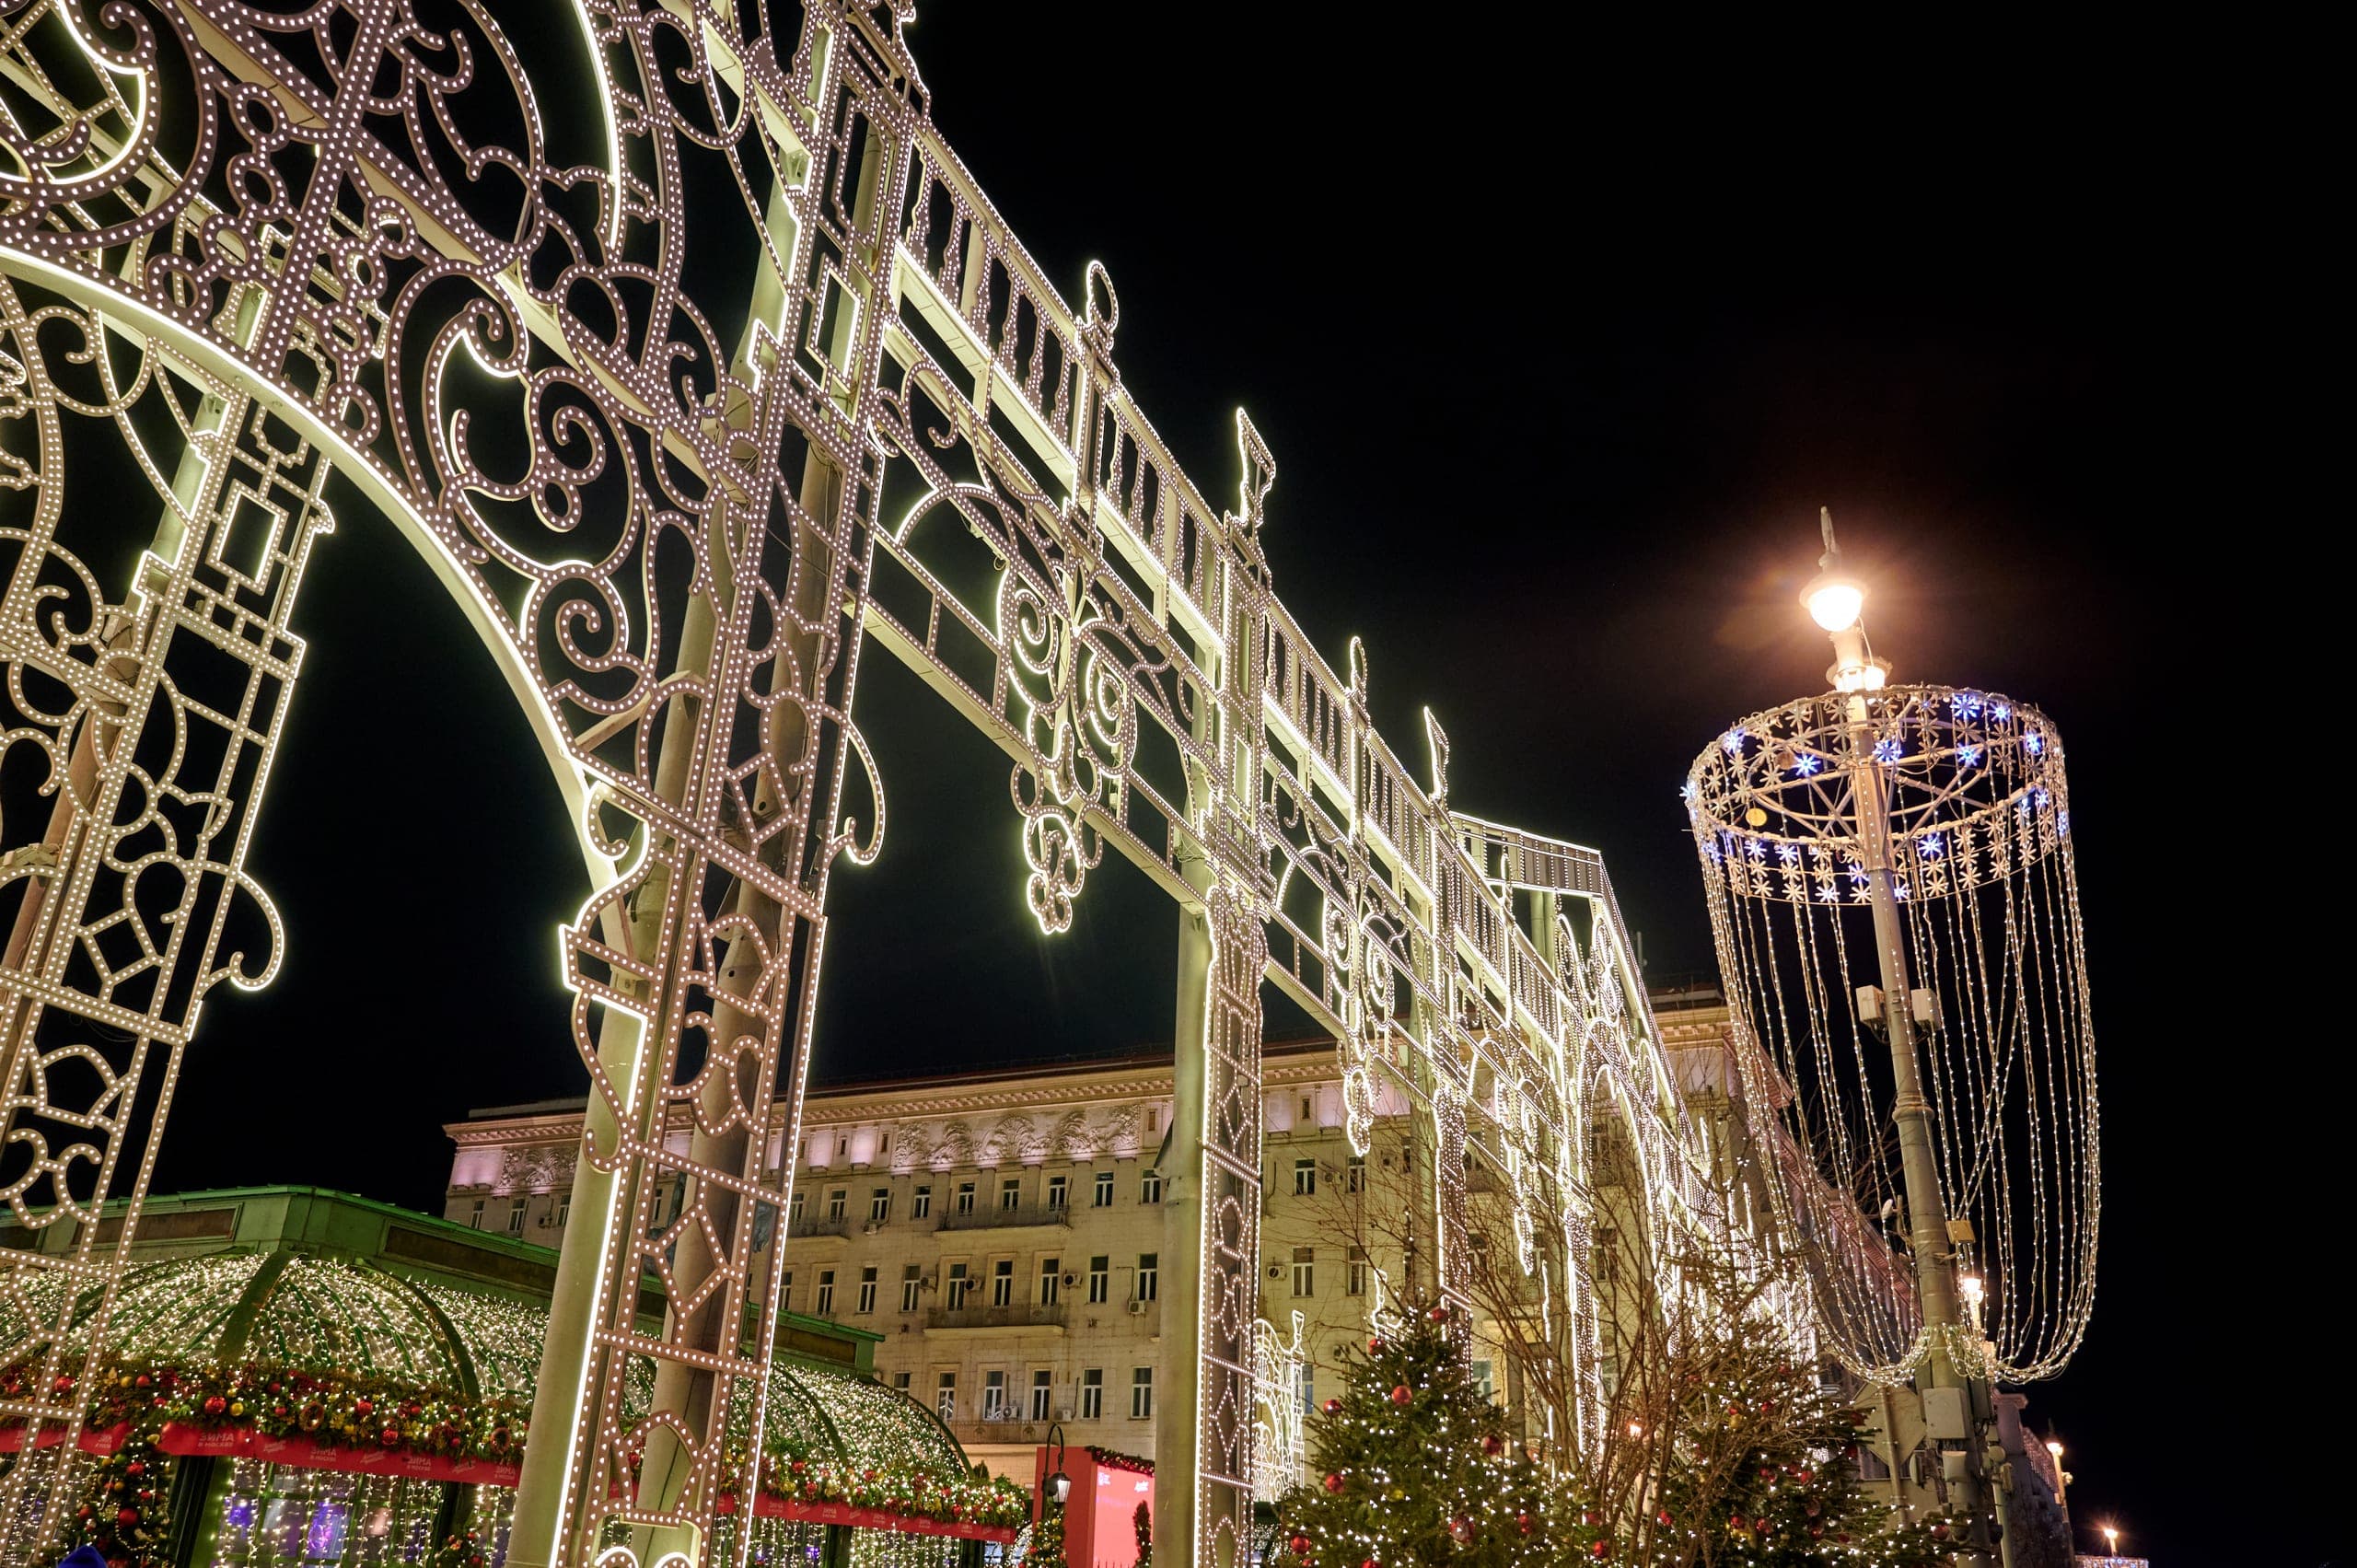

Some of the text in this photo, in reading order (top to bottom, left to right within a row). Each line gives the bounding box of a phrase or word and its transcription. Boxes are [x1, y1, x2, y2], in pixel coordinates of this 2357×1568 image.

[199, 1432, 235, 1442] ЗИМА
[310, 1446, 337, 1457] ЗИМА
[407, 1457, 432, 1467] ЗИМА
